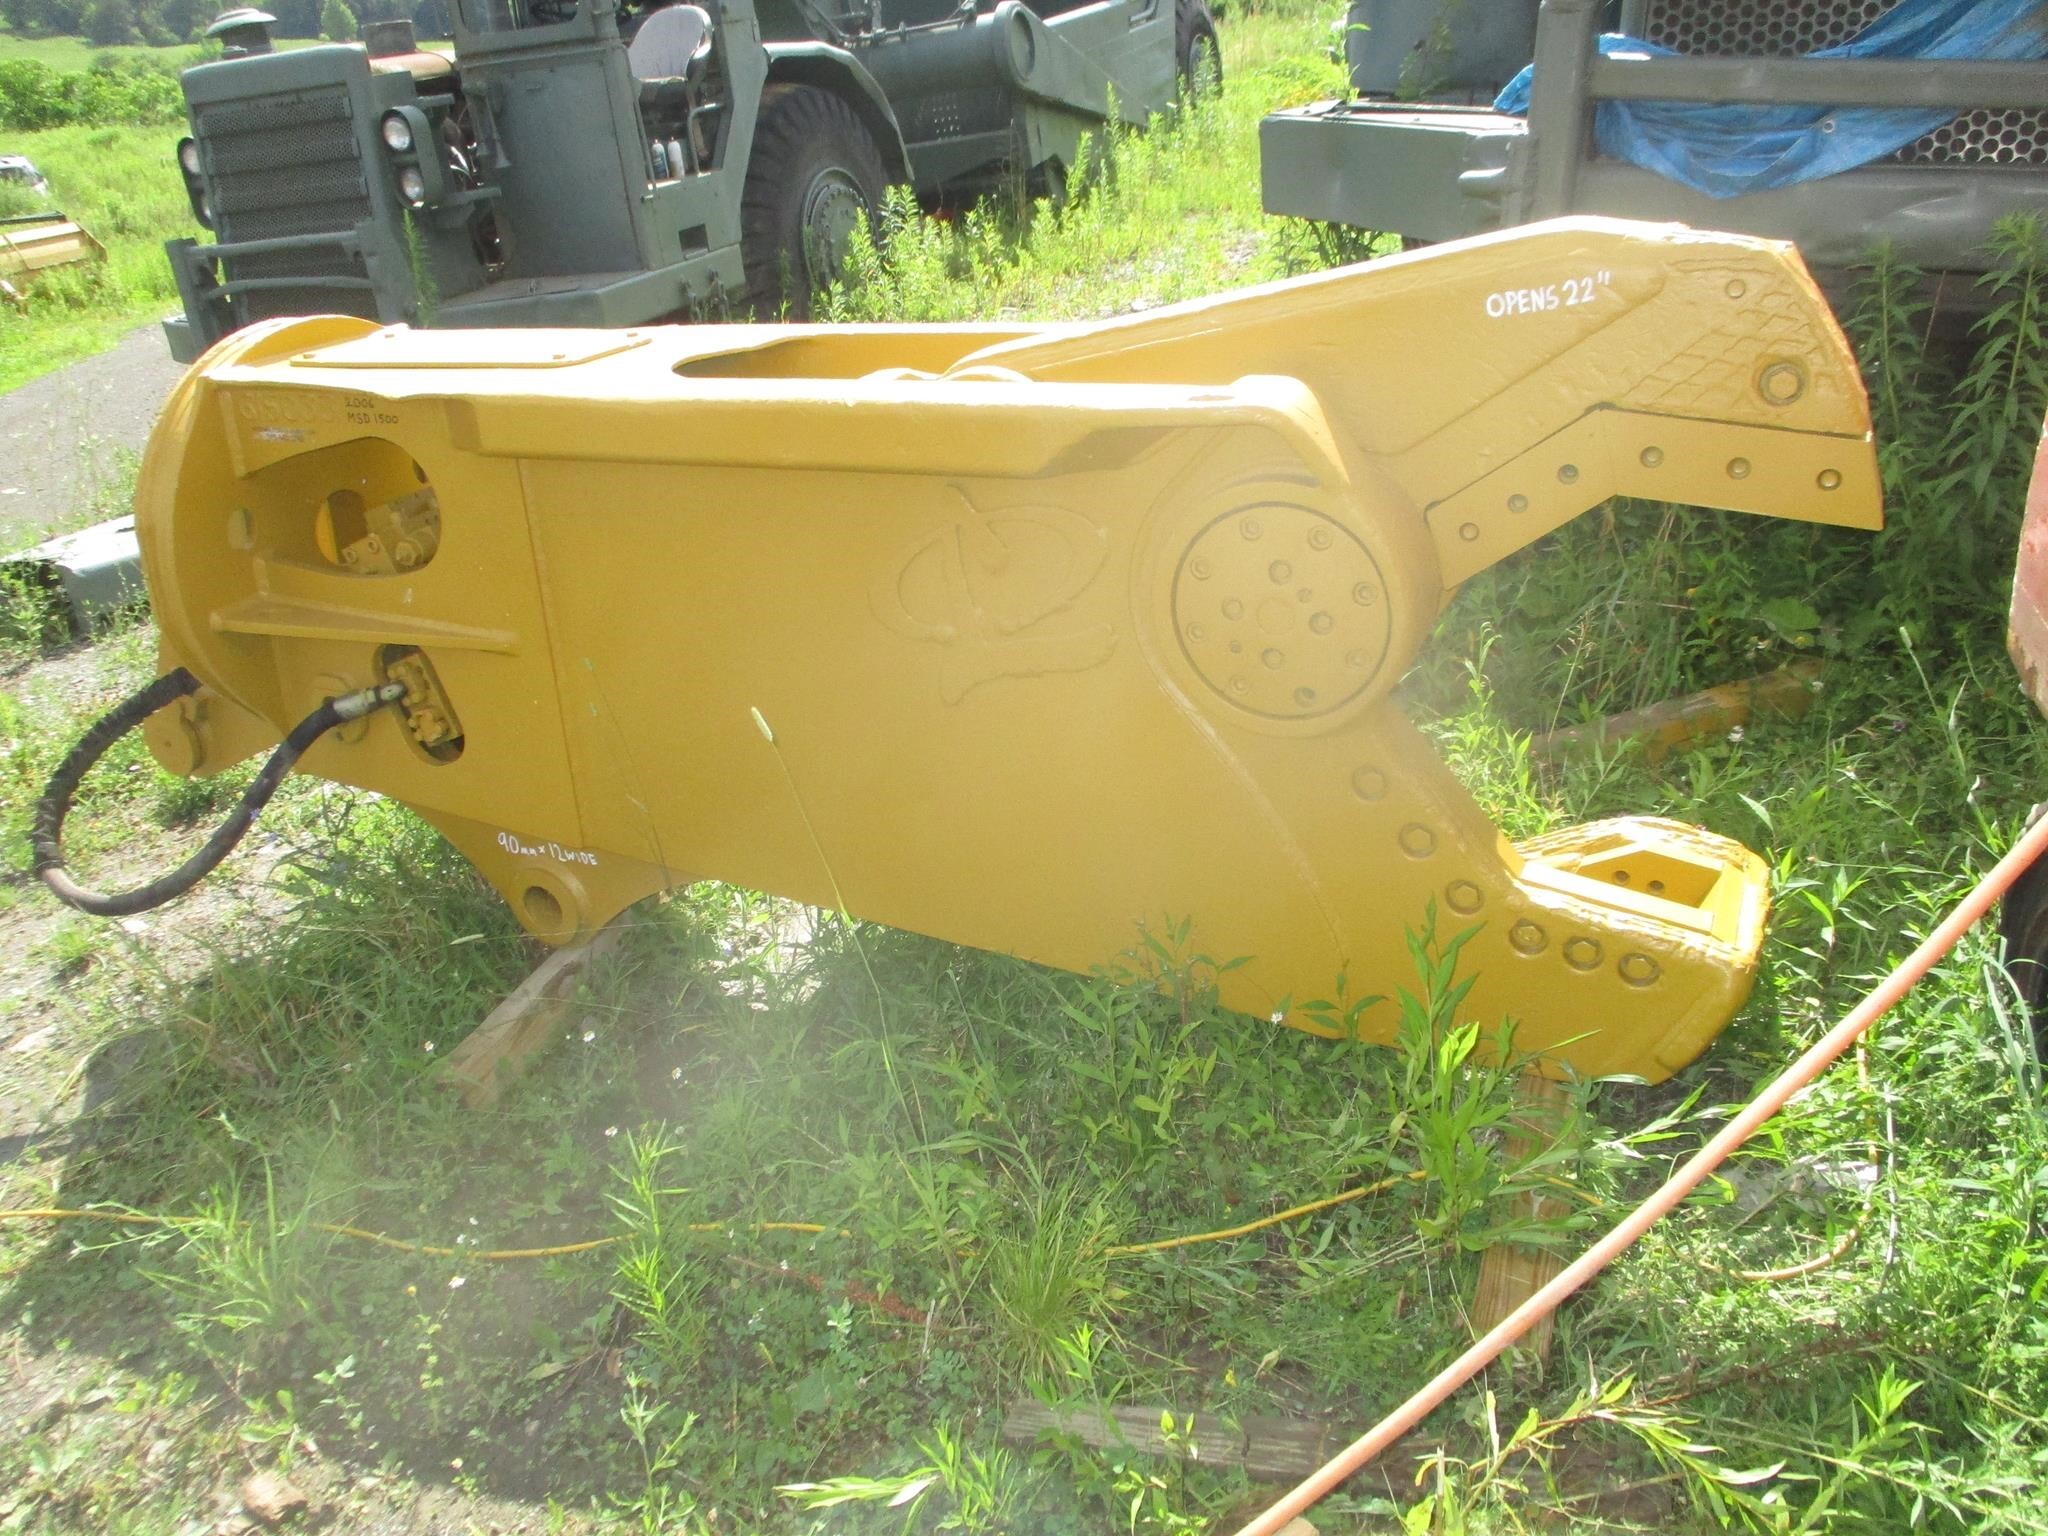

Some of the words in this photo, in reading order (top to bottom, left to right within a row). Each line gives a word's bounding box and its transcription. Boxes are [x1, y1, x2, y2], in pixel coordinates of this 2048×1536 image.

[1486, 285, 1560, 318] OPENS
[1561, 270, 1611, 306] 22"
[347, 412, 370, 425] MSD
[374, 413, 400, 425] 1500
